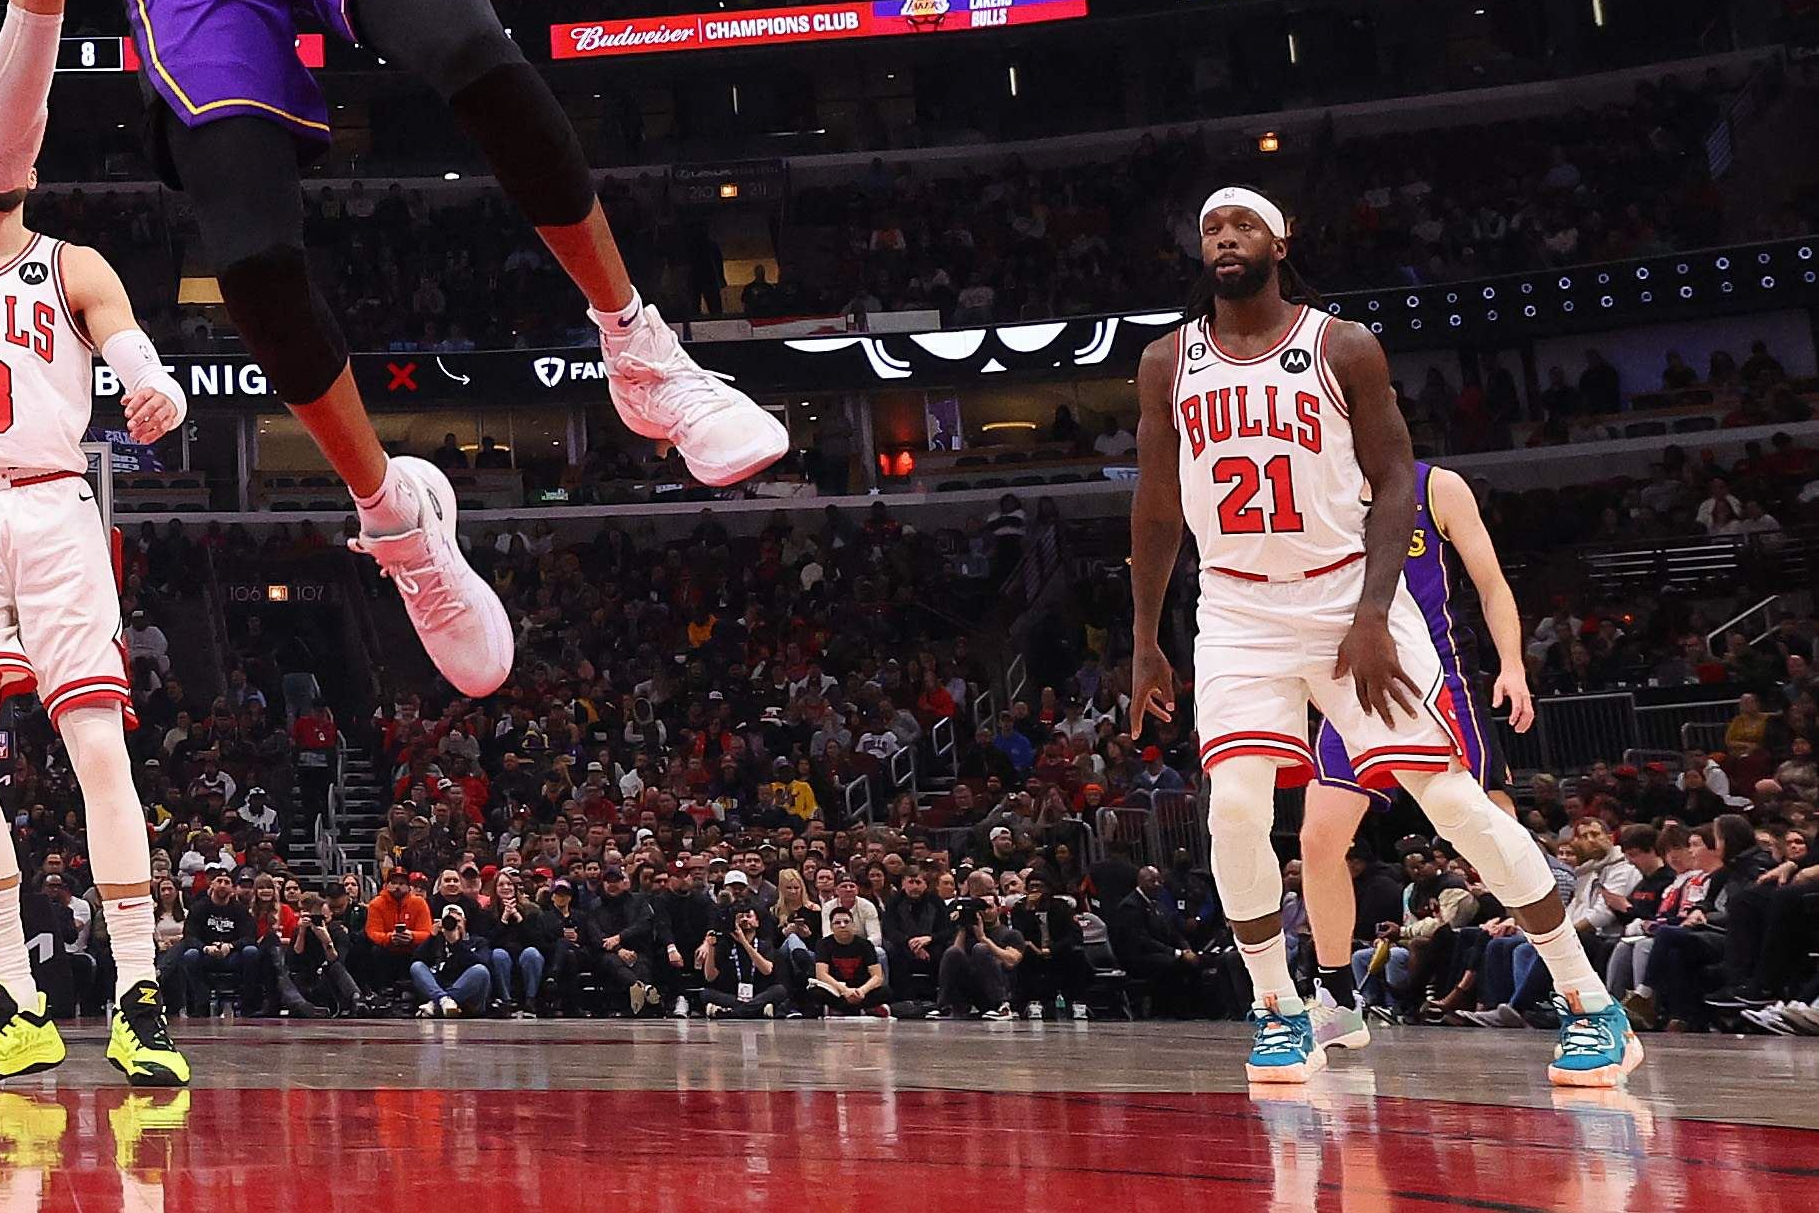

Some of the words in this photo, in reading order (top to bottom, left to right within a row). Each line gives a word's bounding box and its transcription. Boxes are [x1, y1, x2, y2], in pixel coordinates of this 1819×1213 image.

[570, 24, 695, 51] Budweiser
[705, 15, 810, 39] CHAMPIONS
[812, 11, 859, 32] CLUB
[971, 8, 1008, 28] BULLS
[81, 41, 96, 67] 8
[1180, 385, 1322, 460] BULLS
[1211, 453, 1305, 535] 21
